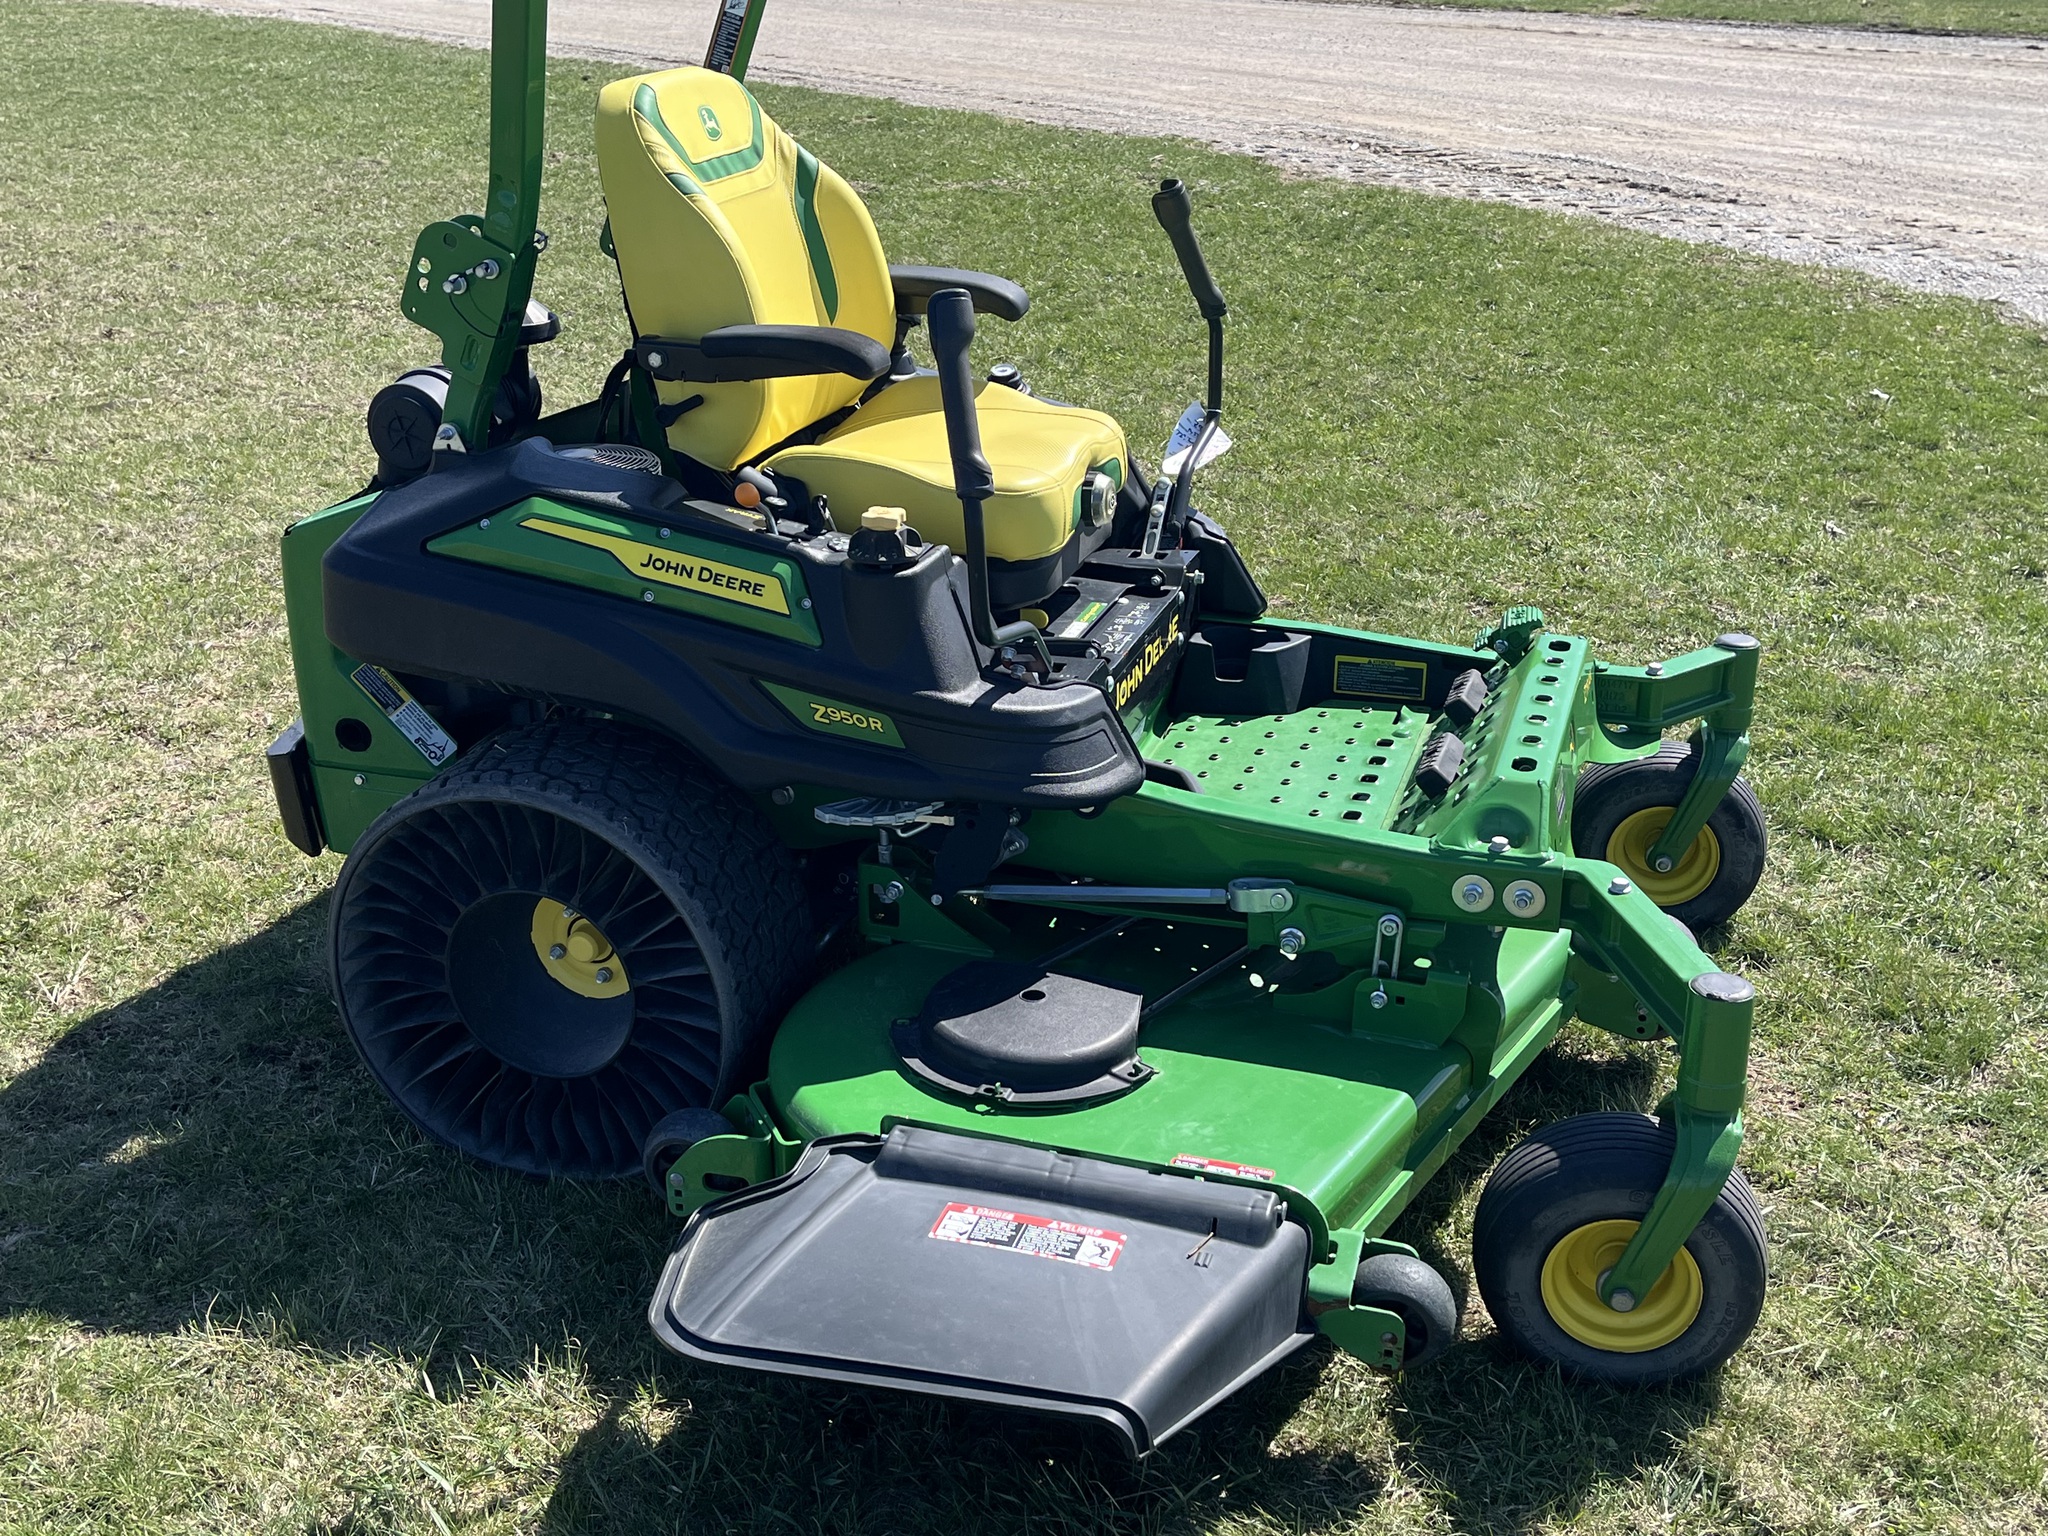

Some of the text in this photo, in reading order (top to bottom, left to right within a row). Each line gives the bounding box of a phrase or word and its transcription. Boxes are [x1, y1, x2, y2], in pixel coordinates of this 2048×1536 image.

[639, 553, 766, 597] JOHN DEERE
[1115, 658, 1144, 711] JOHN
[809, 702, 884, 733] Z950R
[975, 1206, 1015, 1220] DANGER
[1059, 1221, 1104, 1237] PELIGRO
